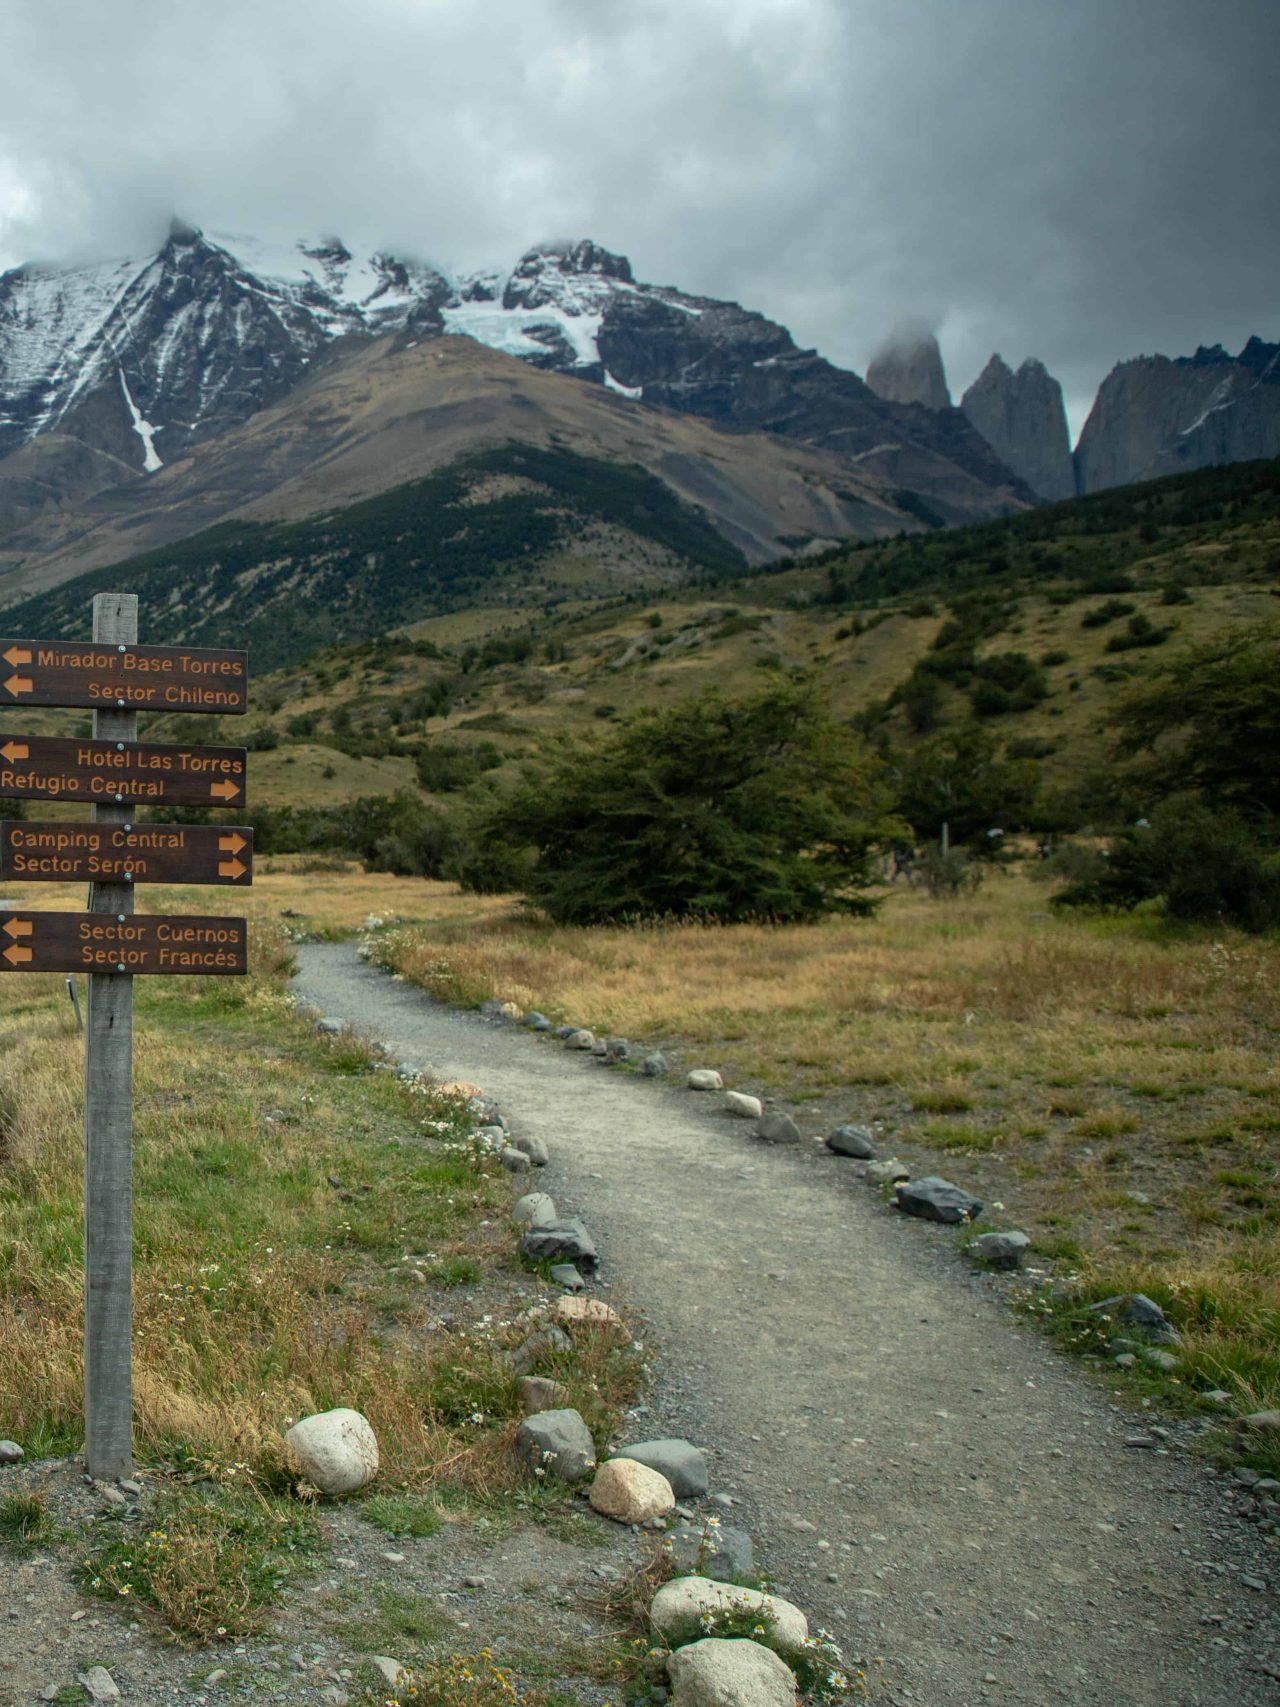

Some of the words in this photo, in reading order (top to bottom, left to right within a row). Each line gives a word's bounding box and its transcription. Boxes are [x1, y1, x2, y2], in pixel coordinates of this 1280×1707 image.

[38, 650, 117, 669] Mirador
[124, 654, 172, 672] Base
[179, 656, 242, 676] Torres
[88, 683, 155, 701] Sector
[166, 687, 240, 705] Chileno
[78, 749, 130, 768] Hotel
[138, 752, 172, 769] Las
[178, 754, 242, 774] Torres
[1, 771, 79, 795] Refugio
[90, 776, 164, 795] Central
[10, 830, 100, 851] Camping
[112, 831, 184, 848] Central
[13, 855, 82, 872] Sector
[88, 856, 147, 873] Serón
[79, 923, 146, 941] Sector
[157, 924, 239, 943] Cuernos
[82, 947, 148, 964] Sector
[160, 948, 237, 966] Francés
